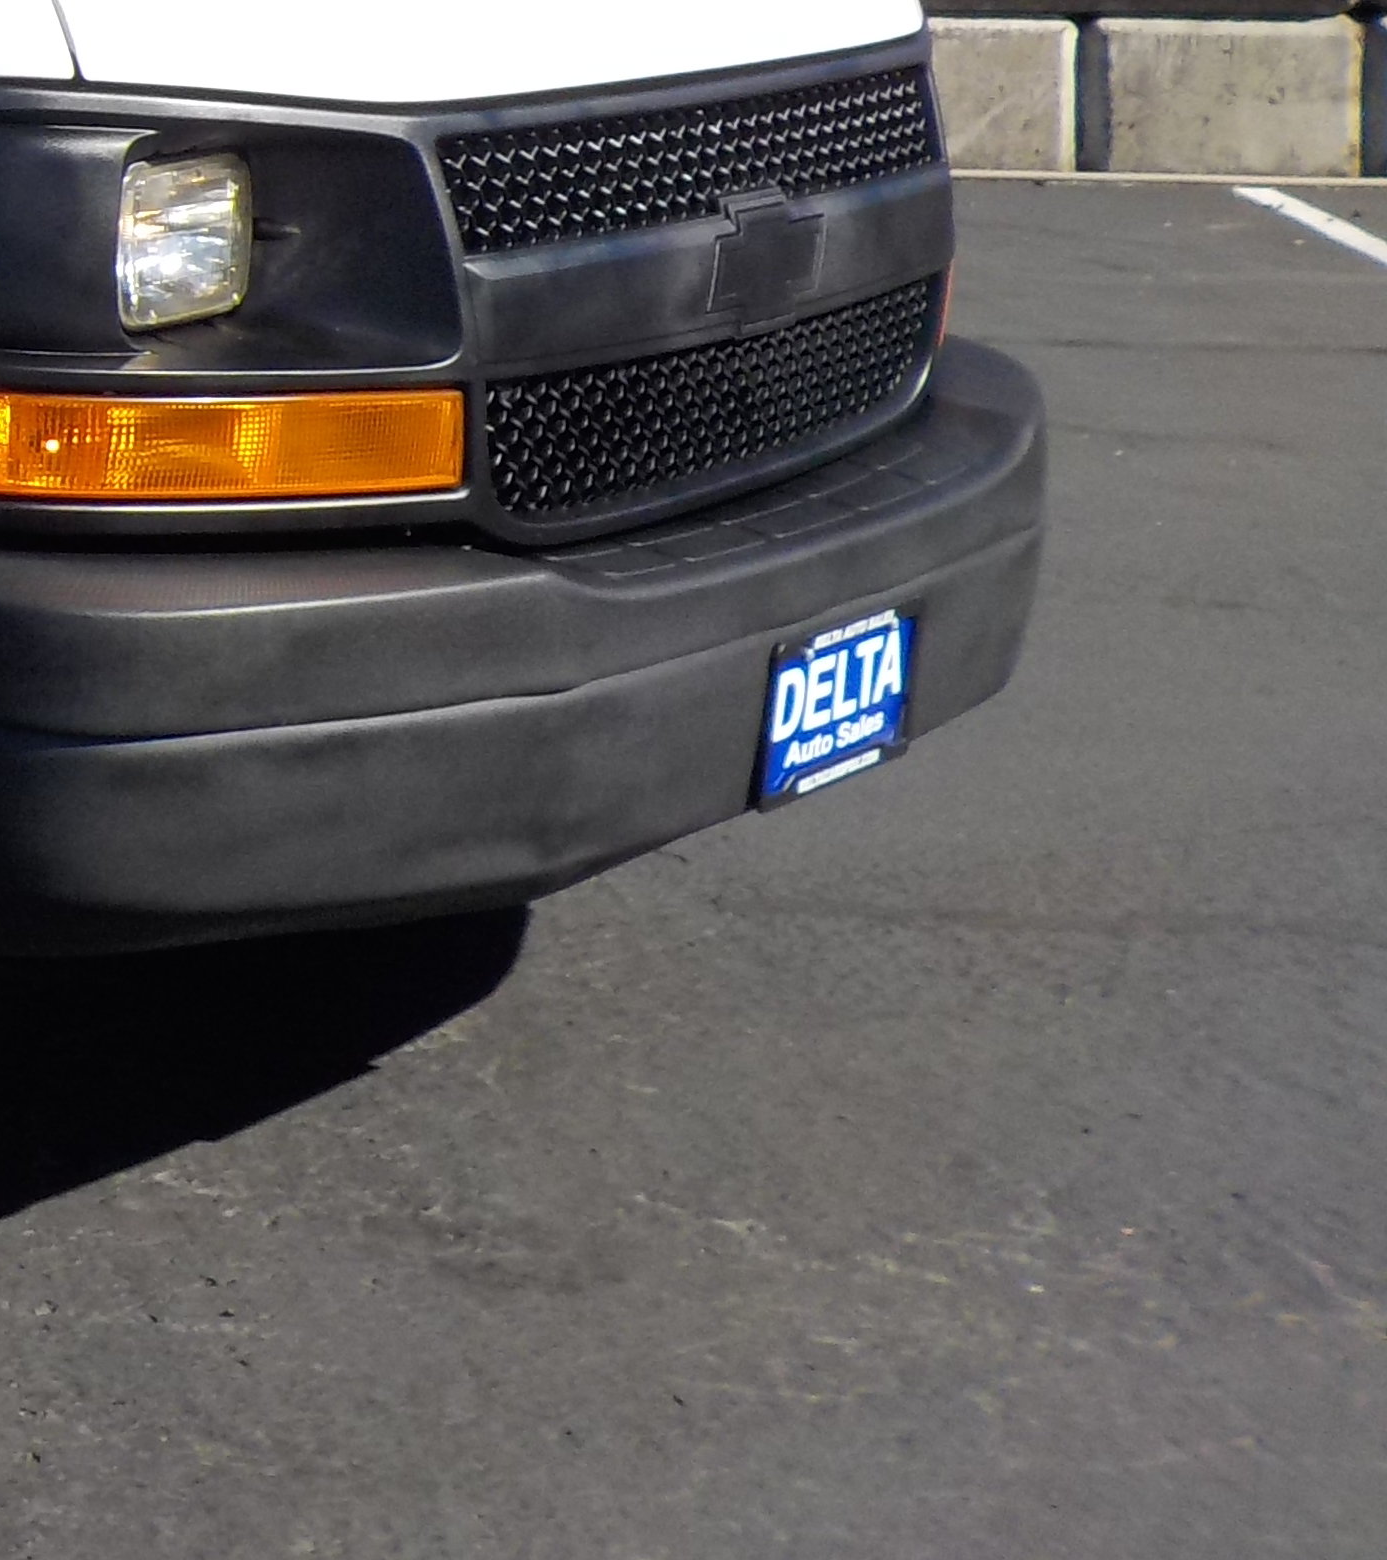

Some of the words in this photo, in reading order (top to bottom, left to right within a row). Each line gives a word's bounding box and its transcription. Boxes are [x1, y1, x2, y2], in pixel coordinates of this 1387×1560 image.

[771, 630, 901, 743] DELTA
[783, 733, 833, 769] Auto
[835, 711, 885, 748] Sales
